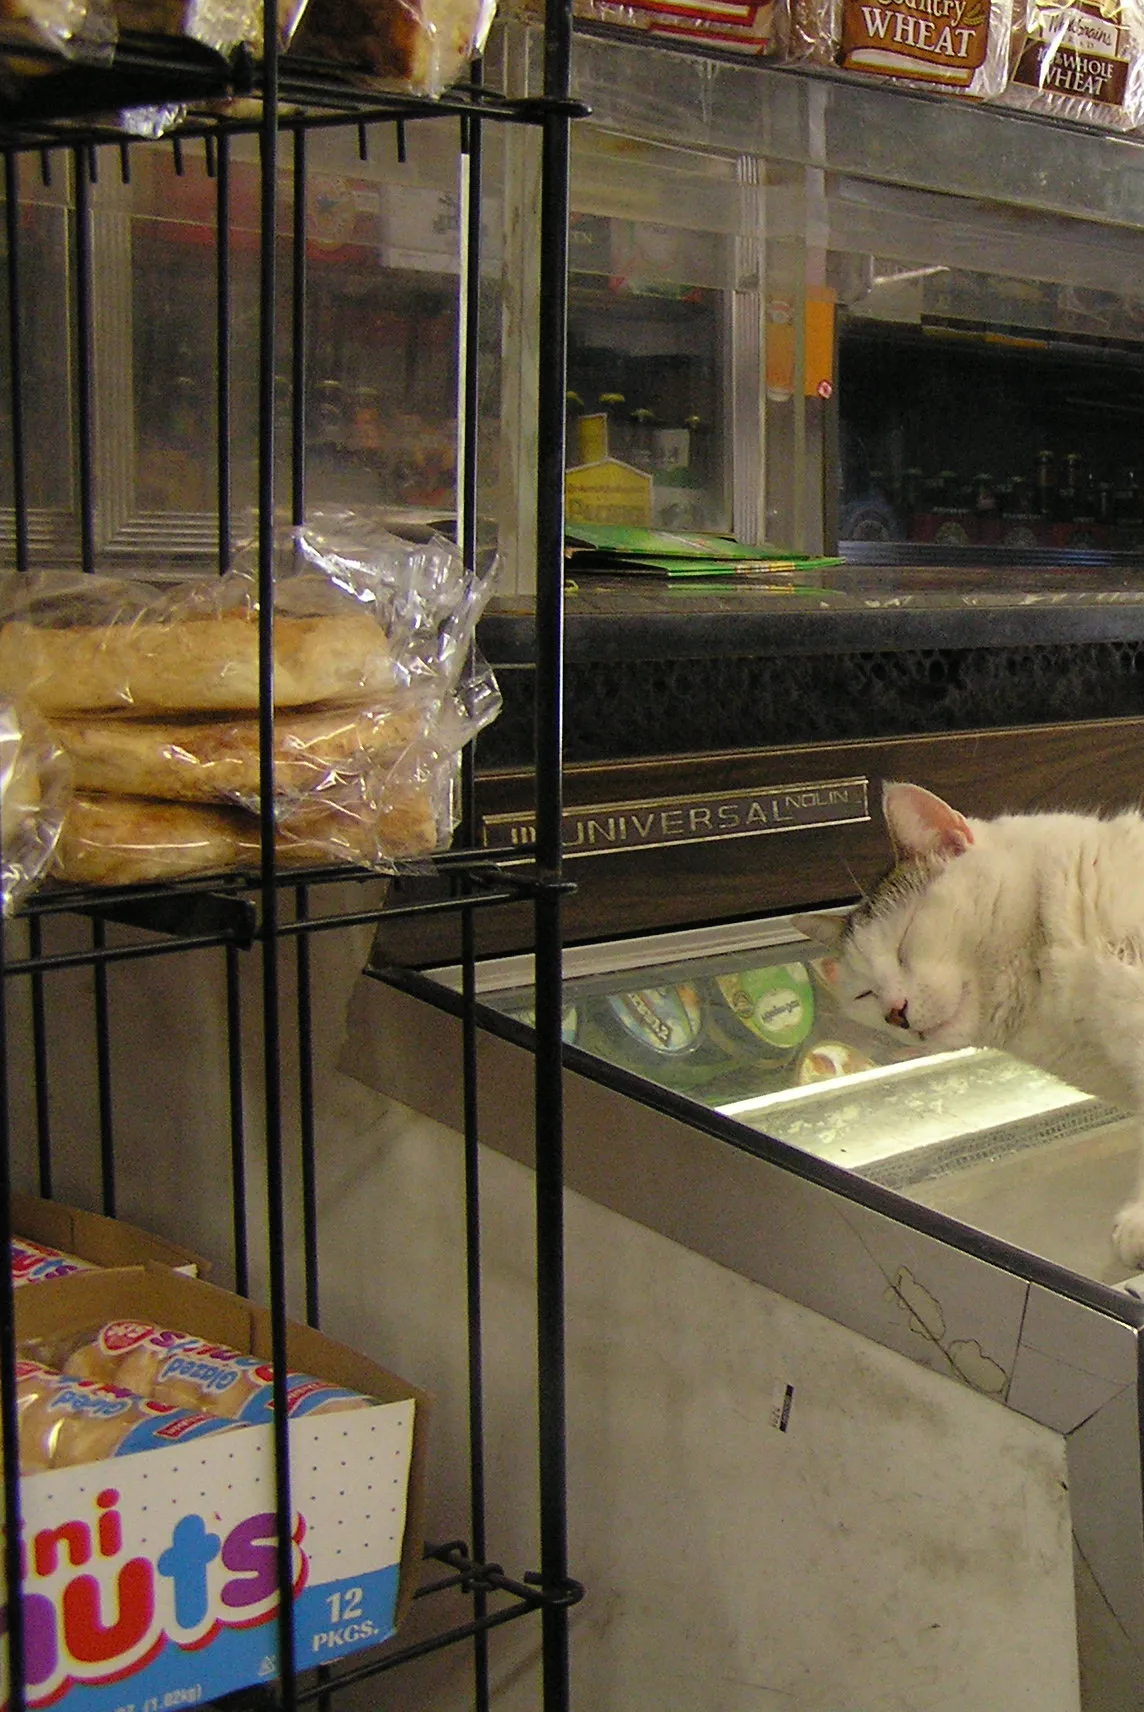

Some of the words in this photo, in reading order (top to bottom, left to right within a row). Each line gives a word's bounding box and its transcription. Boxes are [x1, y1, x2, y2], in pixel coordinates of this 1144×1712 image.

[862, 7, 976, 58] WHEAT
[1062, 53, 1114, 79] WHOLE
[562, 802, 793, 846] UNIVERSAL
[161, 1358, 238, 1391] Glazed
[325, 1587, 363, 1623] 12
[312, 1625, 380, 1652] PKGS.
